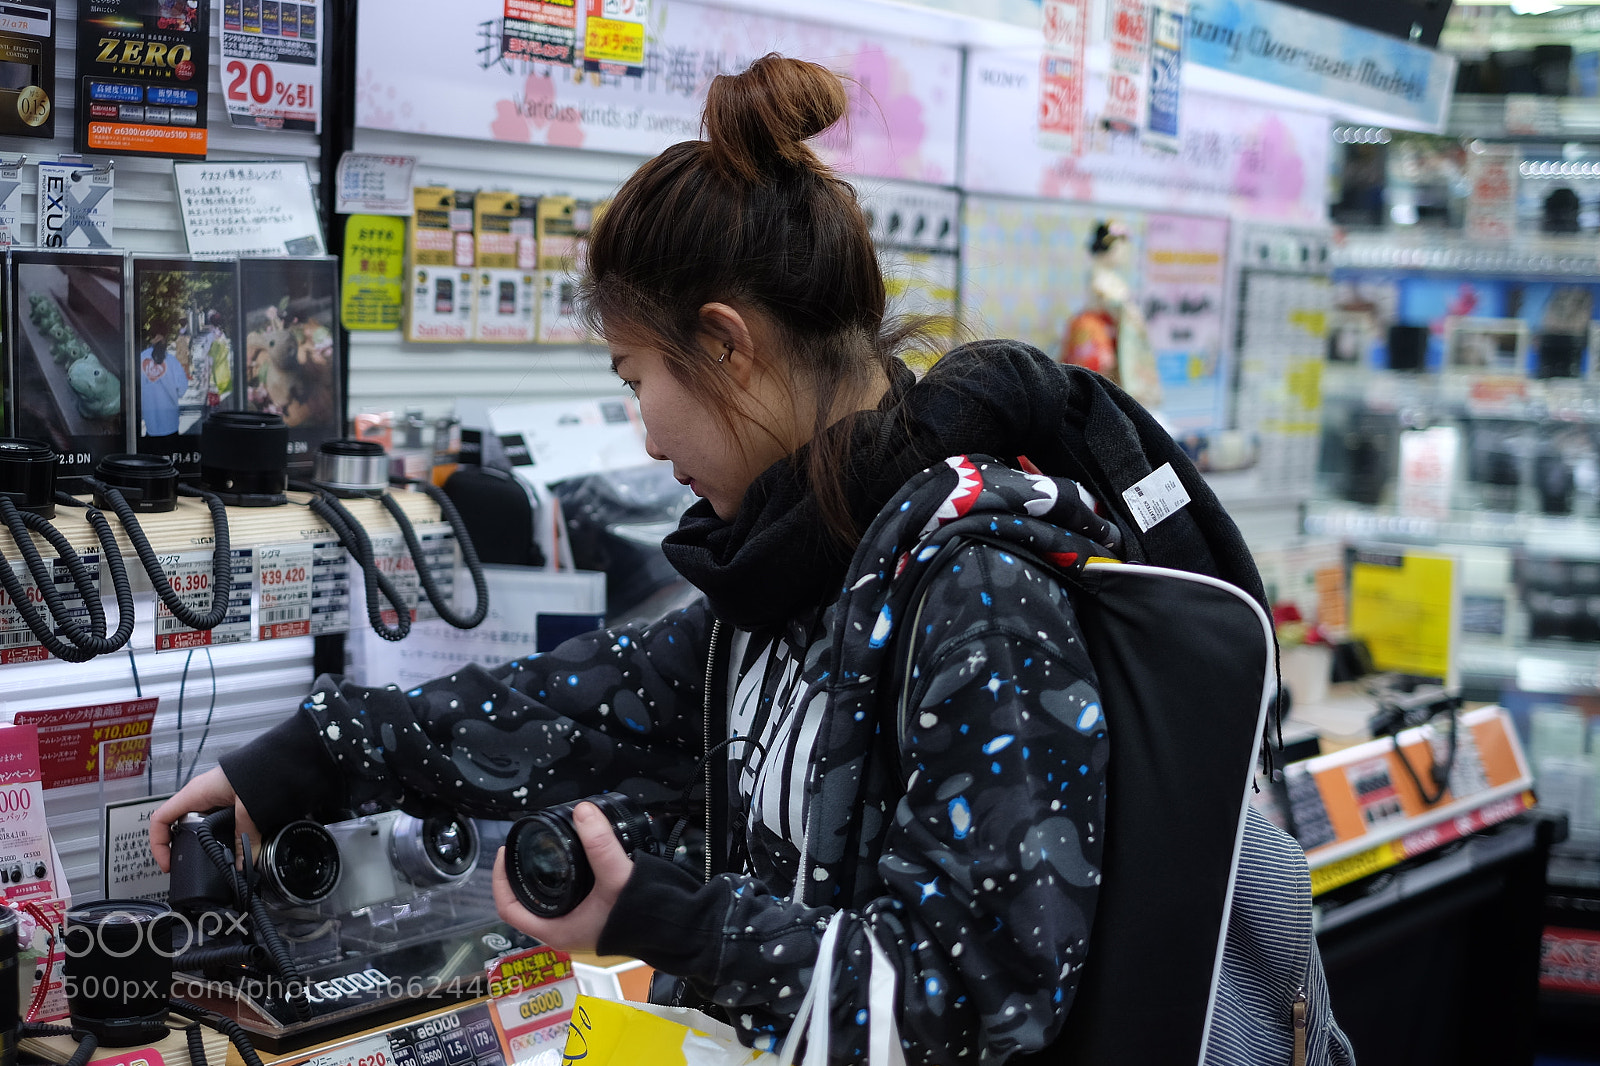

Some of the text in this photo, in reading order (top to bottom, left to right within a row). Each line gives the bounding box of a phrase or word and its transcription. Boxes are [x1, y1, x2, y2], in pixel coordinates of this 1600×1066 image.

[95, 38, 192, 69] ZERO
[113, 66, 172, 78] PREMIUM
[226, 60, 315, 109] 20%引
[21, 97, 46, 116] 0.15
[514, 95, 575, 122] Various
[92, 125, 112, 134] SONY
[46, 176, 63, 248] EXUS
[72, 220, 106, 228] PROTECT
[76, 454, 92, 465] DN
[158, 555, 181, 565] シグマ
[261, 549, 281, 559] シグマ
[261, 567, 306, 585] ¥39,420
[174, 632, 207, 641] バーコード
[7, 647, 43, 657] バーコード
[93, 720, 149, 742] ¥10,000
[520, 988, 562, 1019] α6000
